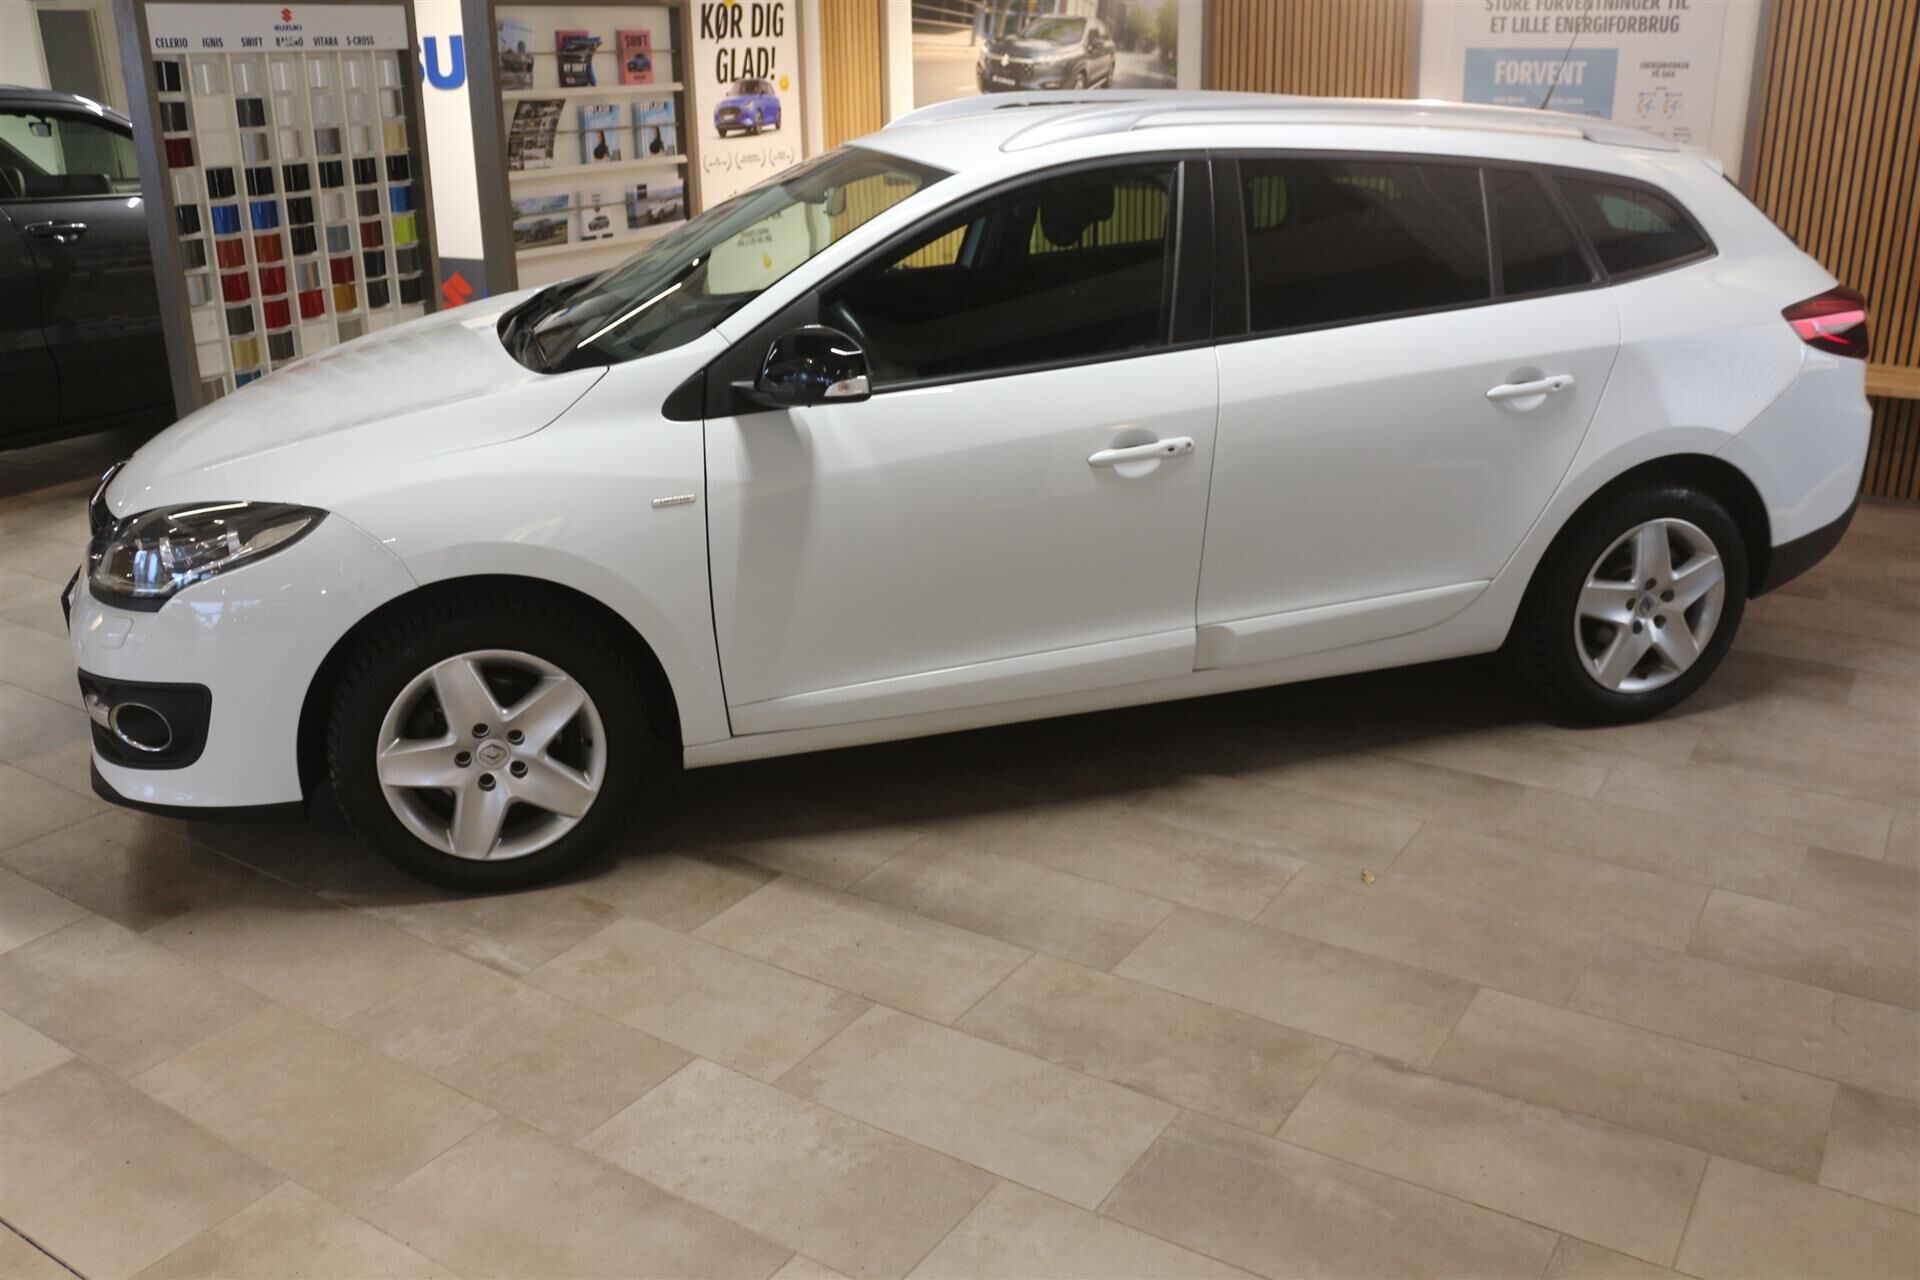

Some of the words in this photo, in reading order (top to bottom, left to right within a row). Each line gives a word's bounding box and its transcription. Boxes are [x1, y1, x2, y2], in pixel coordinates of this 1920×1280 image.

[1536, 0, 1660, 11] FORVENTNINGER
[701, 2, 743, 43] KØR
[751, 2, 785, 38] DIG
[1490, 16, 1507, 33] ET
[1512, 16, 1550, 33] LILLE
[1555, 15, 1680, 33] ENERGIFORBRUG
[155, 37, 188, 48] CELERIO
[202, 37, 223, 48] IGNIS
[241, 37, 263, 48] SWIFT
[313, 36, 338, 47] VITARA
[346, 36, 374, 46] S-CROSS
[716, 46, 776, 84] GLAD!
[1494, 60, 1587, 86] FORVENT
